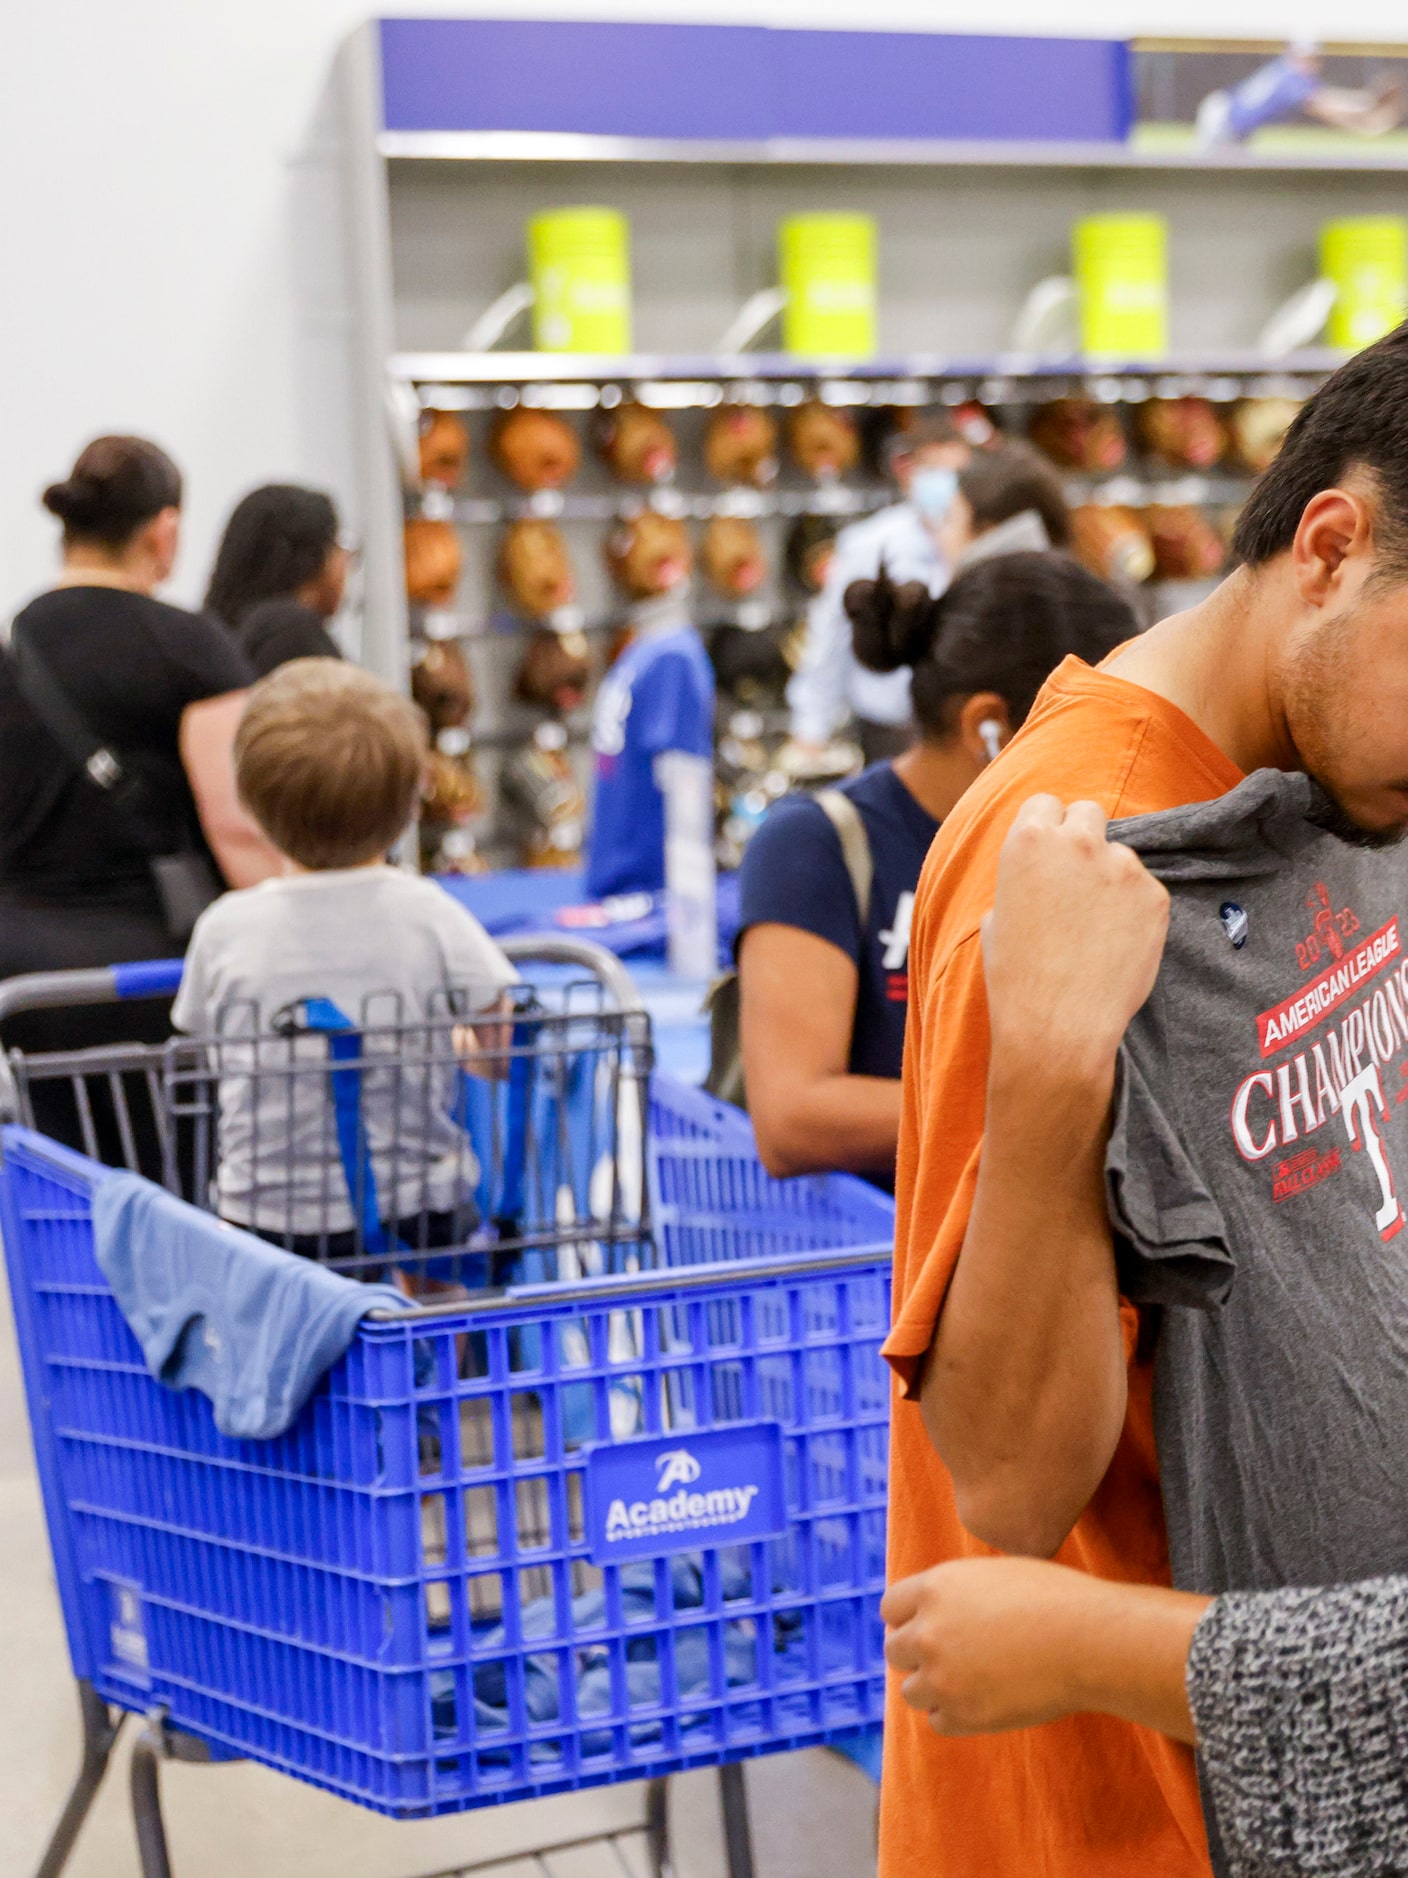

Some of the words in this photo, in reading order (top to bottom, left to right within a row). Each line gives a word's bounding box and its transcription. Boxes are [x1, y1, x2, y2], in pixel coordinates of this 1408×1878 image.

[1295, 935, 1321, 971] 20
[1264, 966, 1350, 1048] AMERICAN
[1349, 924, 1399, 984] LEAGUE
[606, 1484, 759, 1531] Academy
